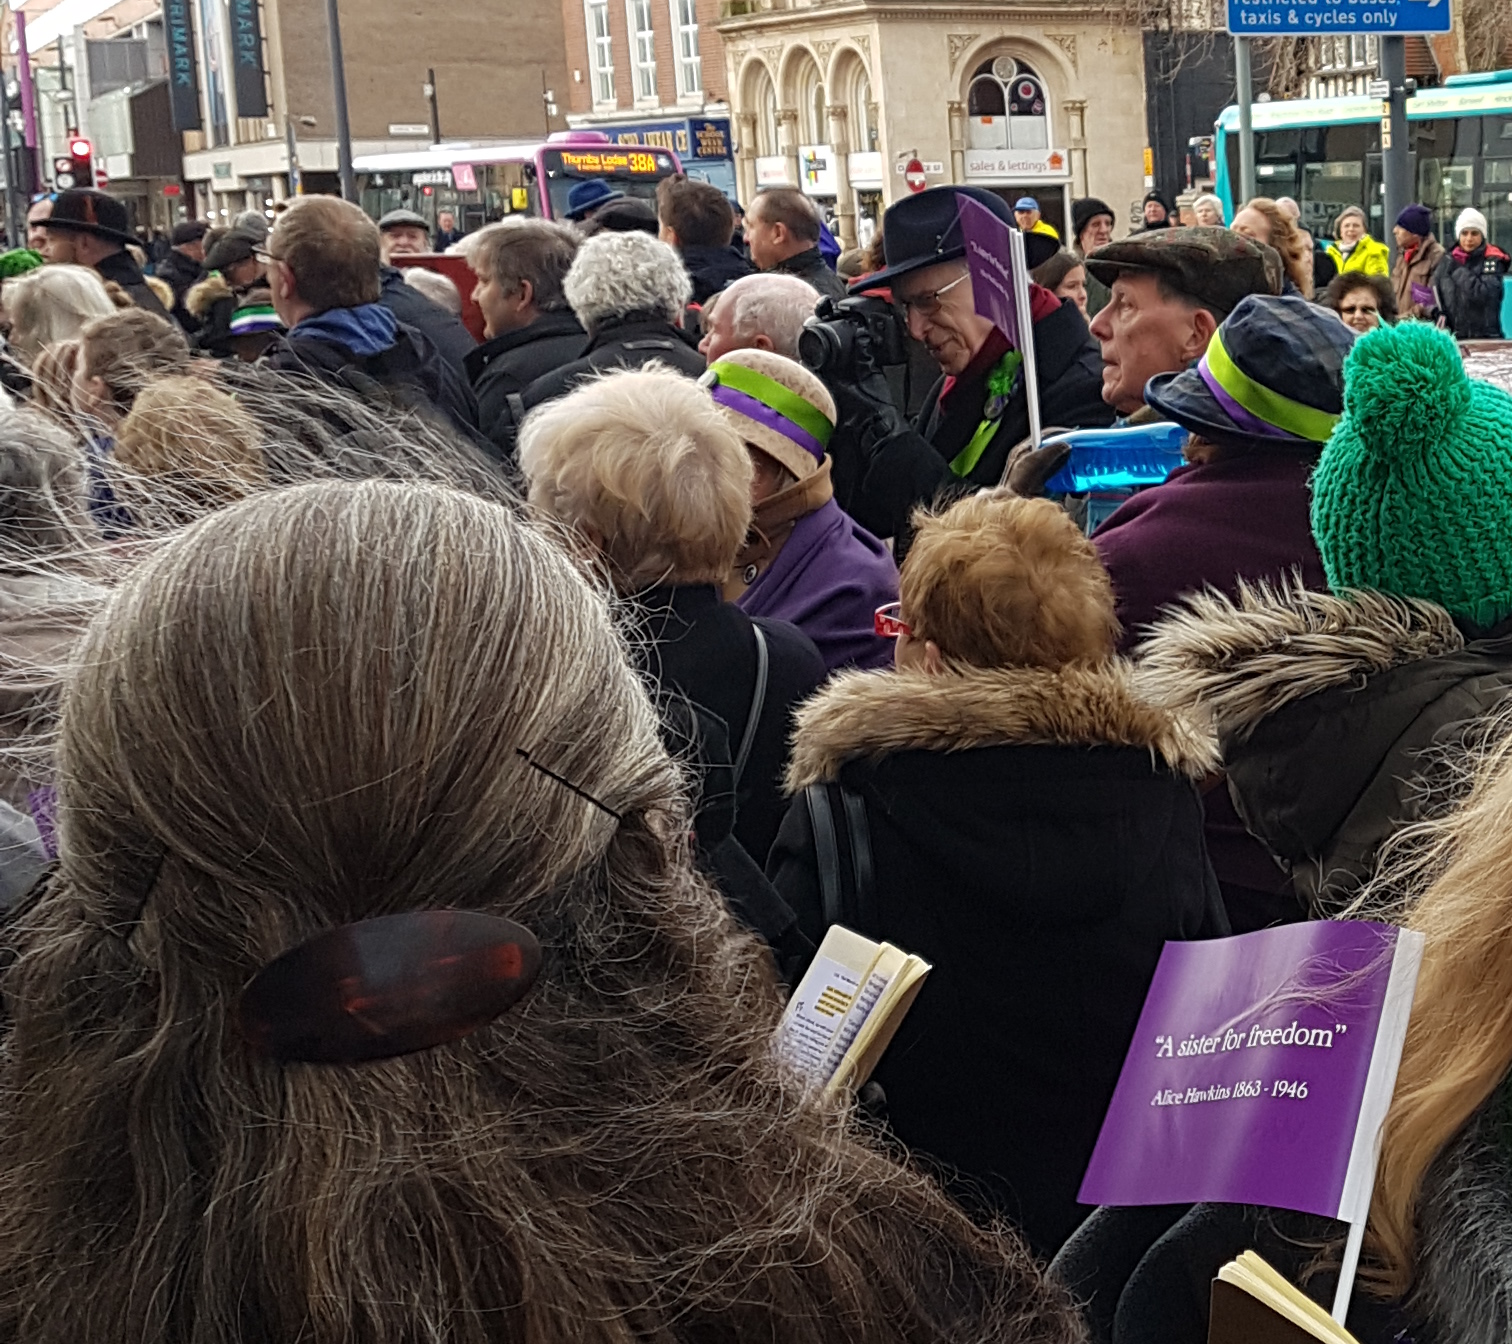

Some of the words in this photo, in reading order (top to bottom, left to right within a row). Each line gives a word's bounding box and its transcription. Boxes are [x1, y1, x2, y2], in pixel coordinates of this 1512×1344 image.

[1240, 10, 1281, 25] taxis
[1288, 10, 1299, 24] &
[1305, 9, 1356, 26] cycles
[1362, 8, 1398, 26] only
[628, 153, 656, 172] 38A
[970, 160, 996, 172] sales
[998, 160, 1006, 171] &
[1008, 159, 1048, 173] lettings
[1155, 1034, 1174, 1058] “A
[1177, 1034, 1220, 1057] sister
[1221, 1029, 1246, 1052] for
[1246, 1020, 1348, 1050] freedom”
[1151, 1090, 1184, 1106] Alice
[1184, 1085, 1231, 1104] Hawkins
[1232, 1080, 1262, 1099] 1863
[1271, 1080, 1308, 1099] 1946
